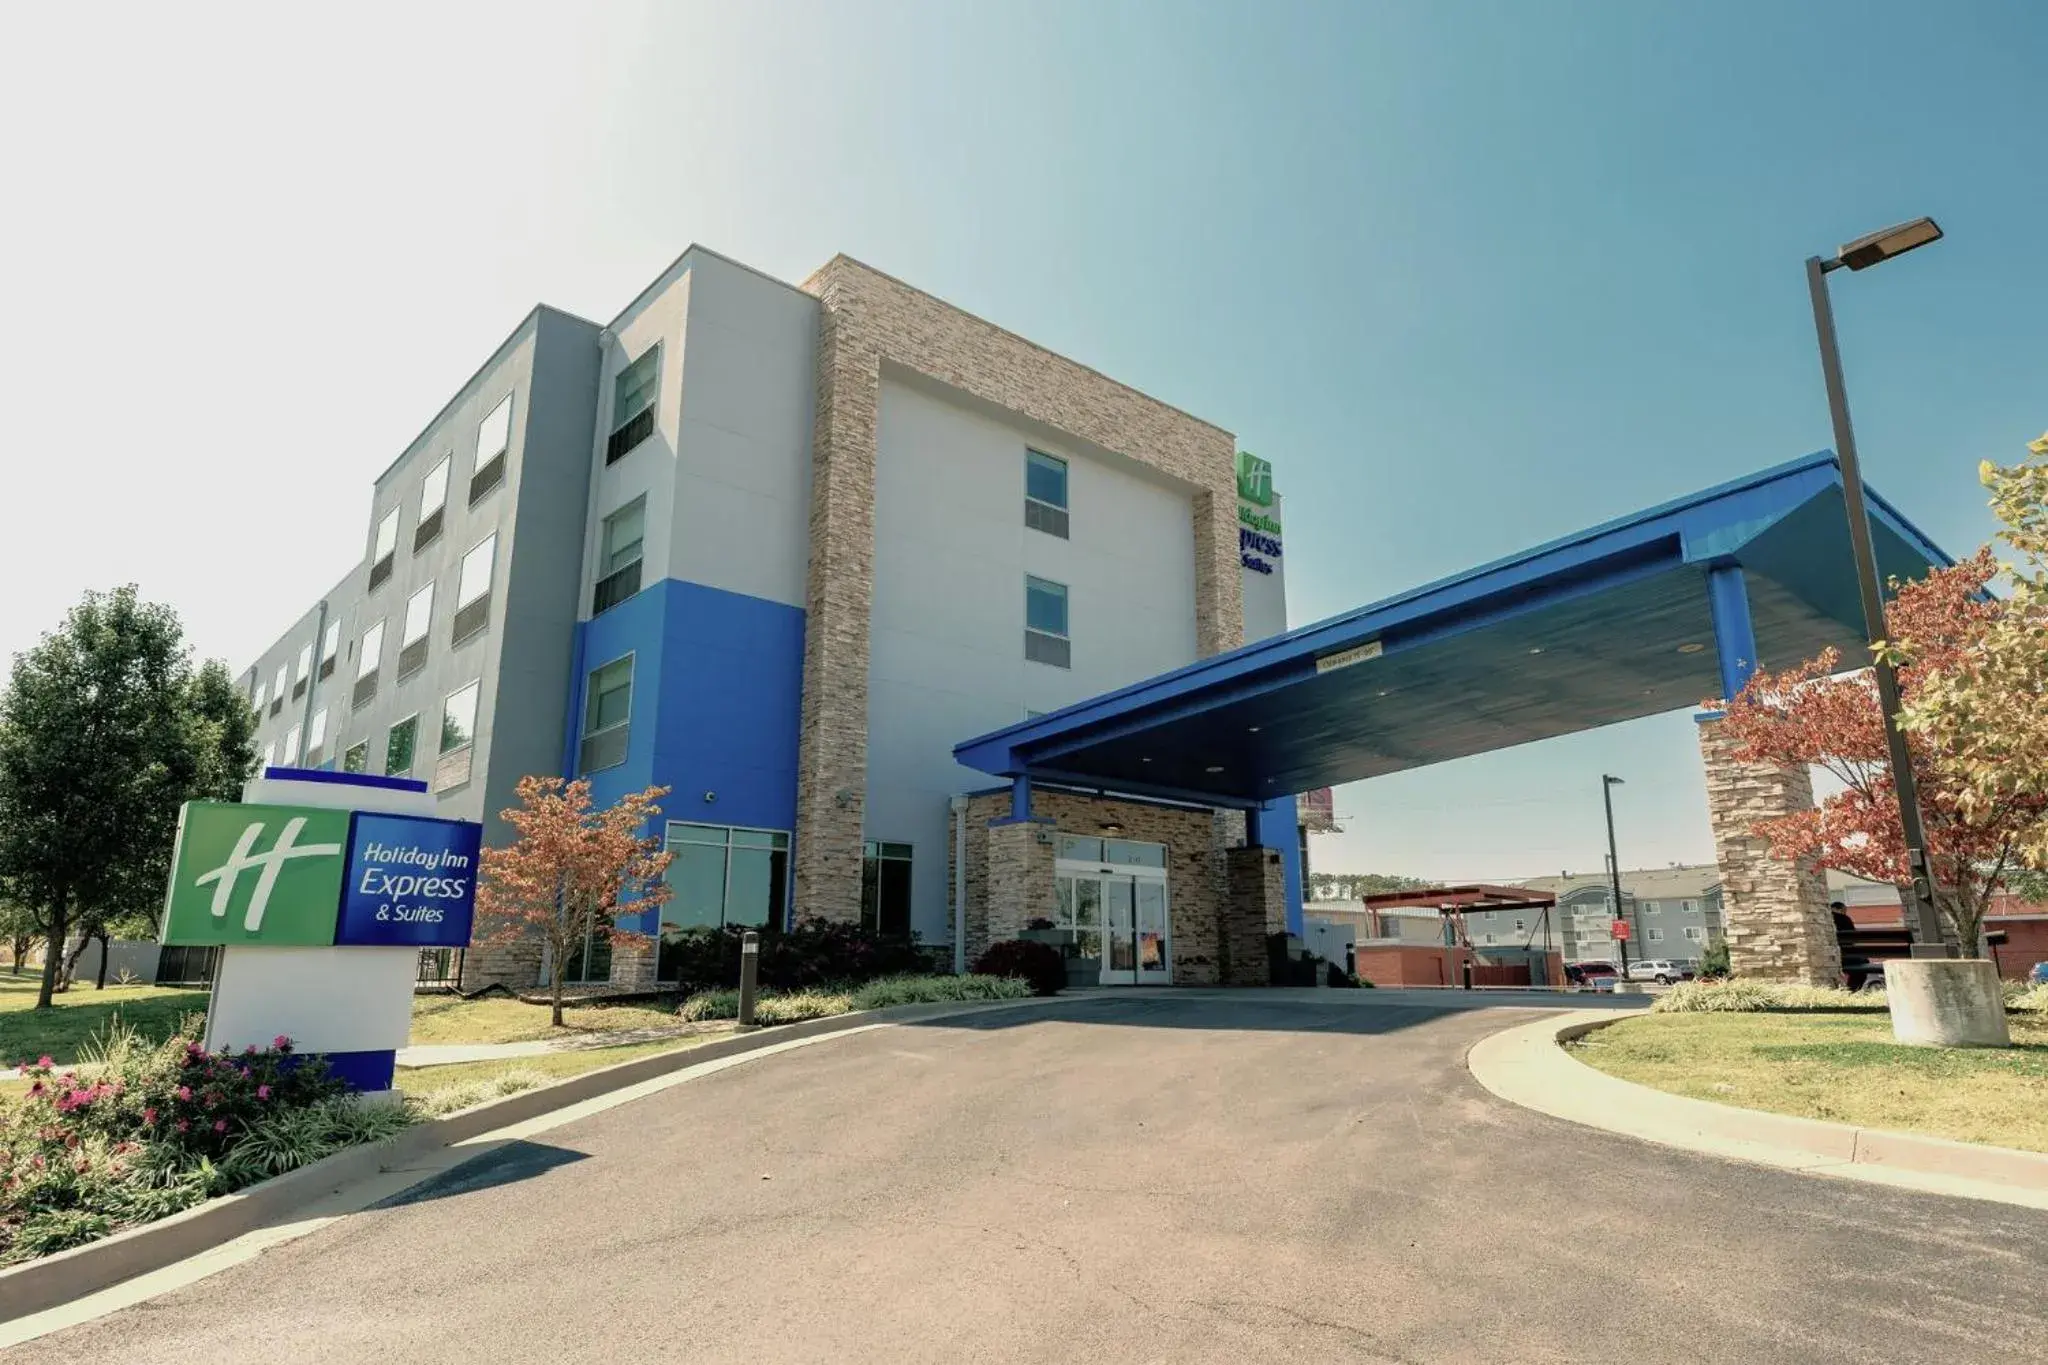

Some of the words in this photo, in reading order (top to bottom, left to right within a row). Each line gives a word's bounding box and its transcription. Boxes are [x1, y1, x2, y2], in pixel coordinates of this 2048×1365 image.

[1239, 527, 1283, 558] press
[364, 842, 440, 871] Holiday
[440, 848, 469, 869] Inn
[359, 867, 467, 903] Express
[375, 903, 390, 921] &
[393, 904, 445, 923] Suites
